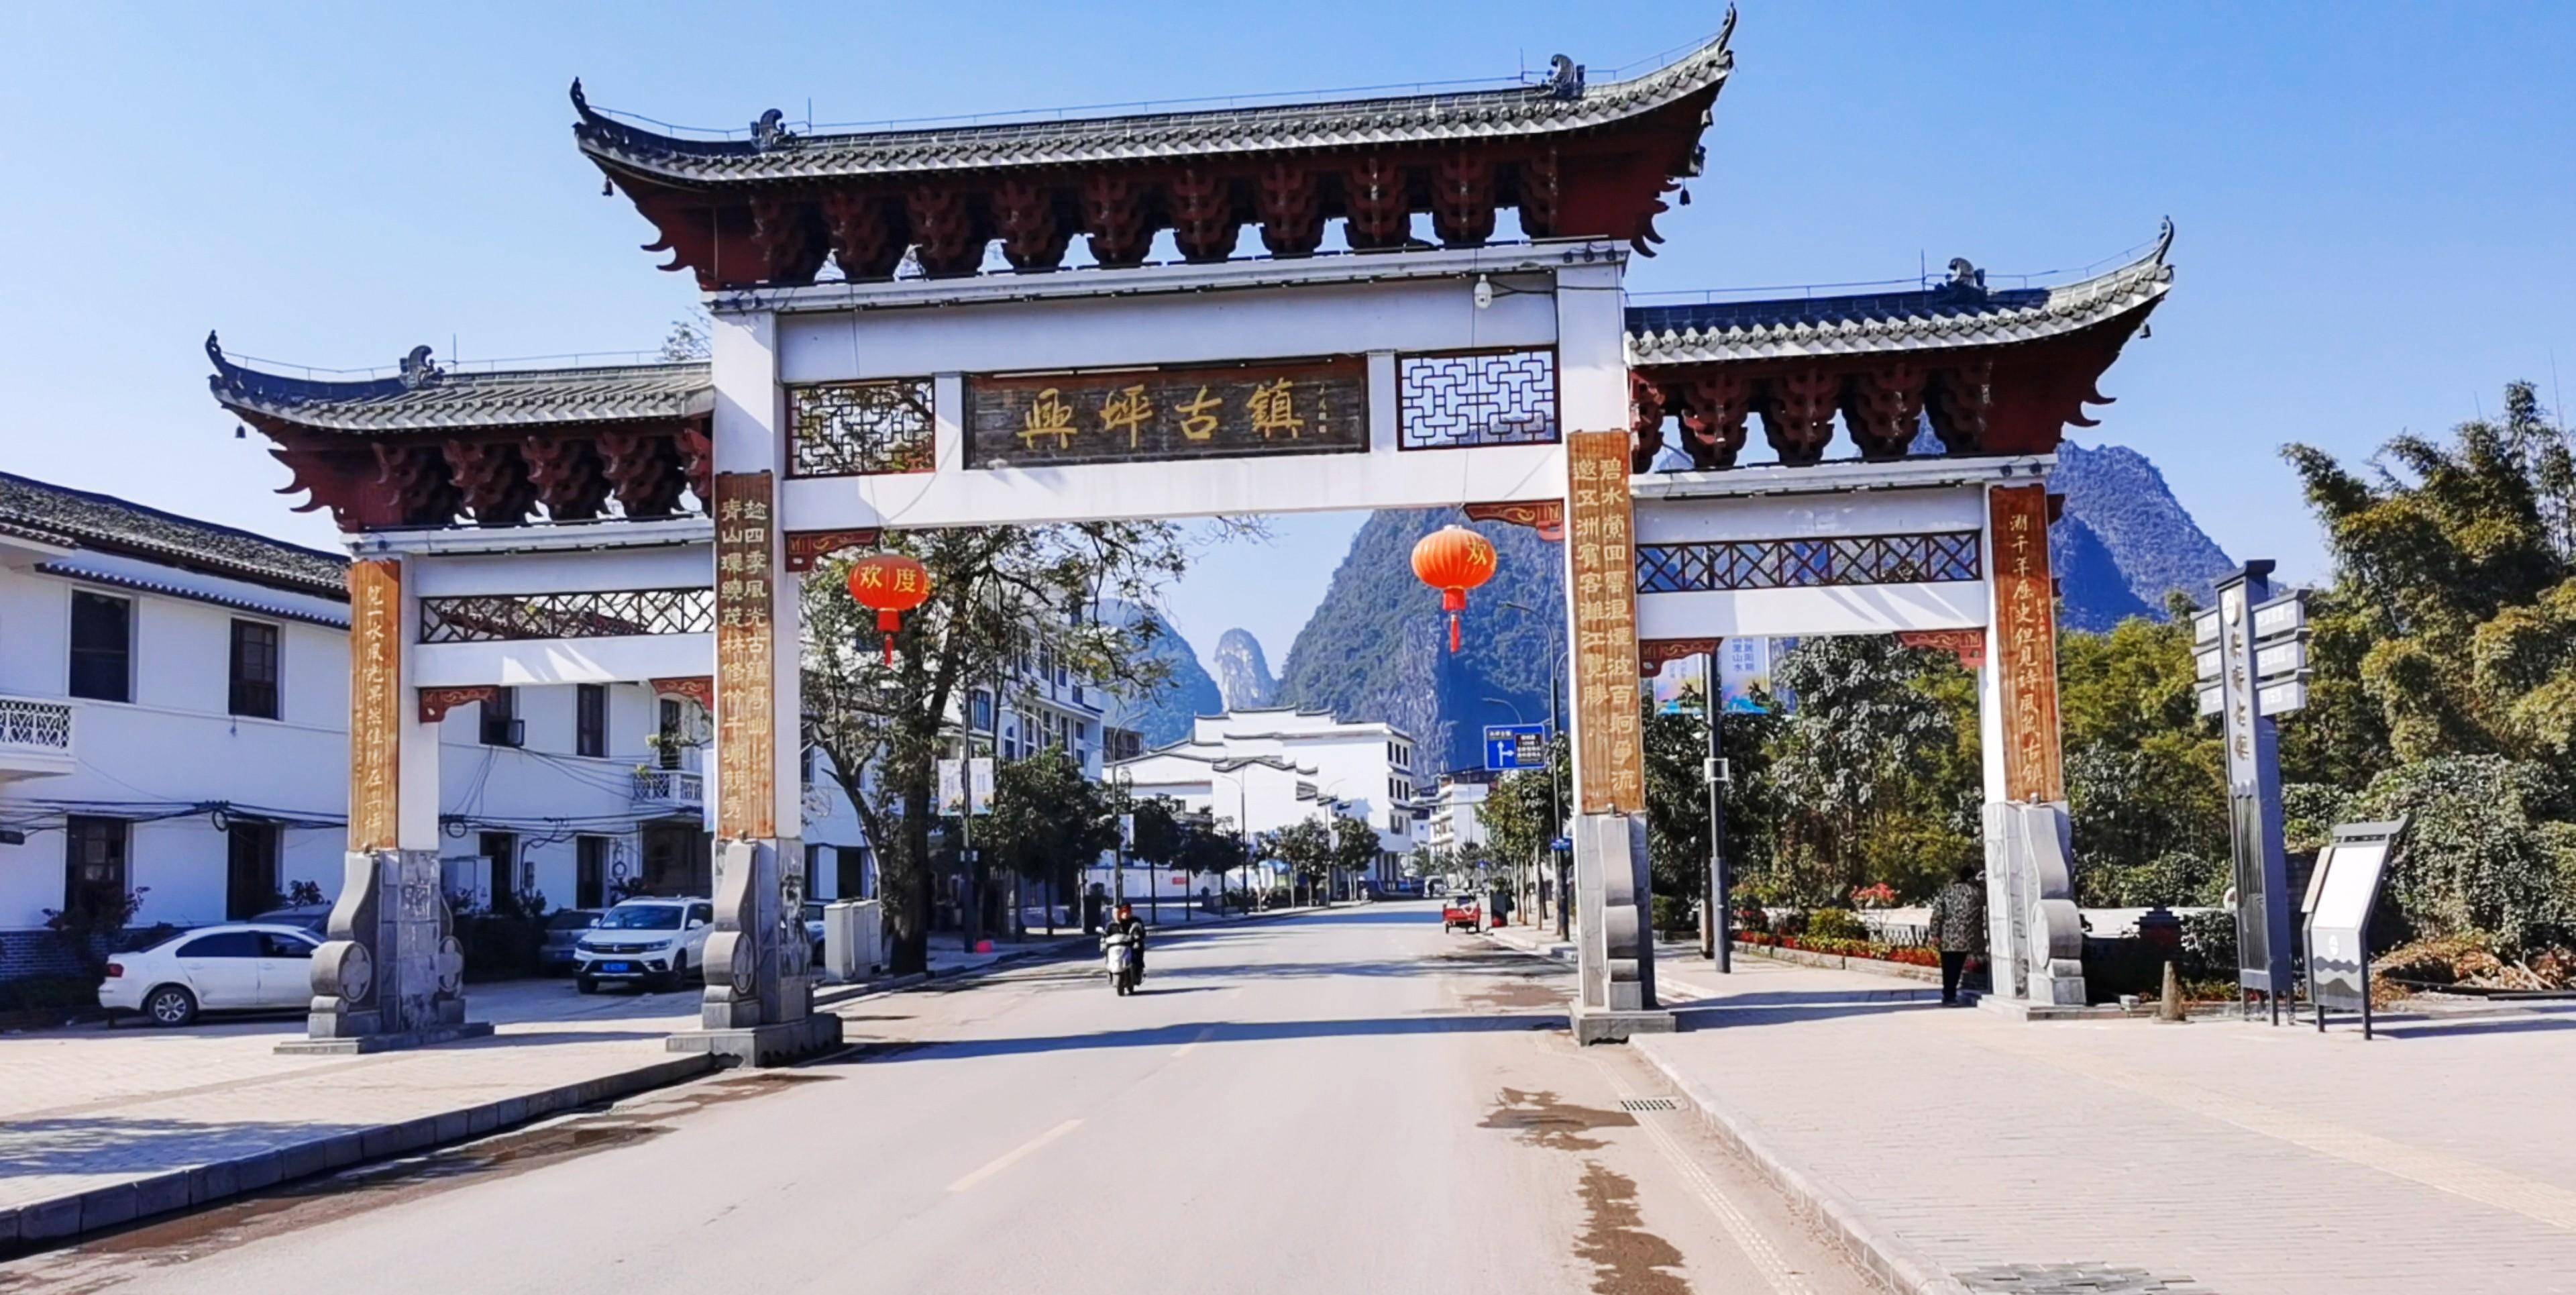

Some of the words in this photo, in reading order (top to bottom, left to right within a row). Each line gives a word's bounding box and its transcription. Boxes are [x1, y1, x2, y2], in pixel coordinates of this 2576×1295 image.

[1017, 378, 1303, 449] 興坪古鎮
[1467, 536, 1487, 566] 欢
[859, 564, 931, 594] 欢度
